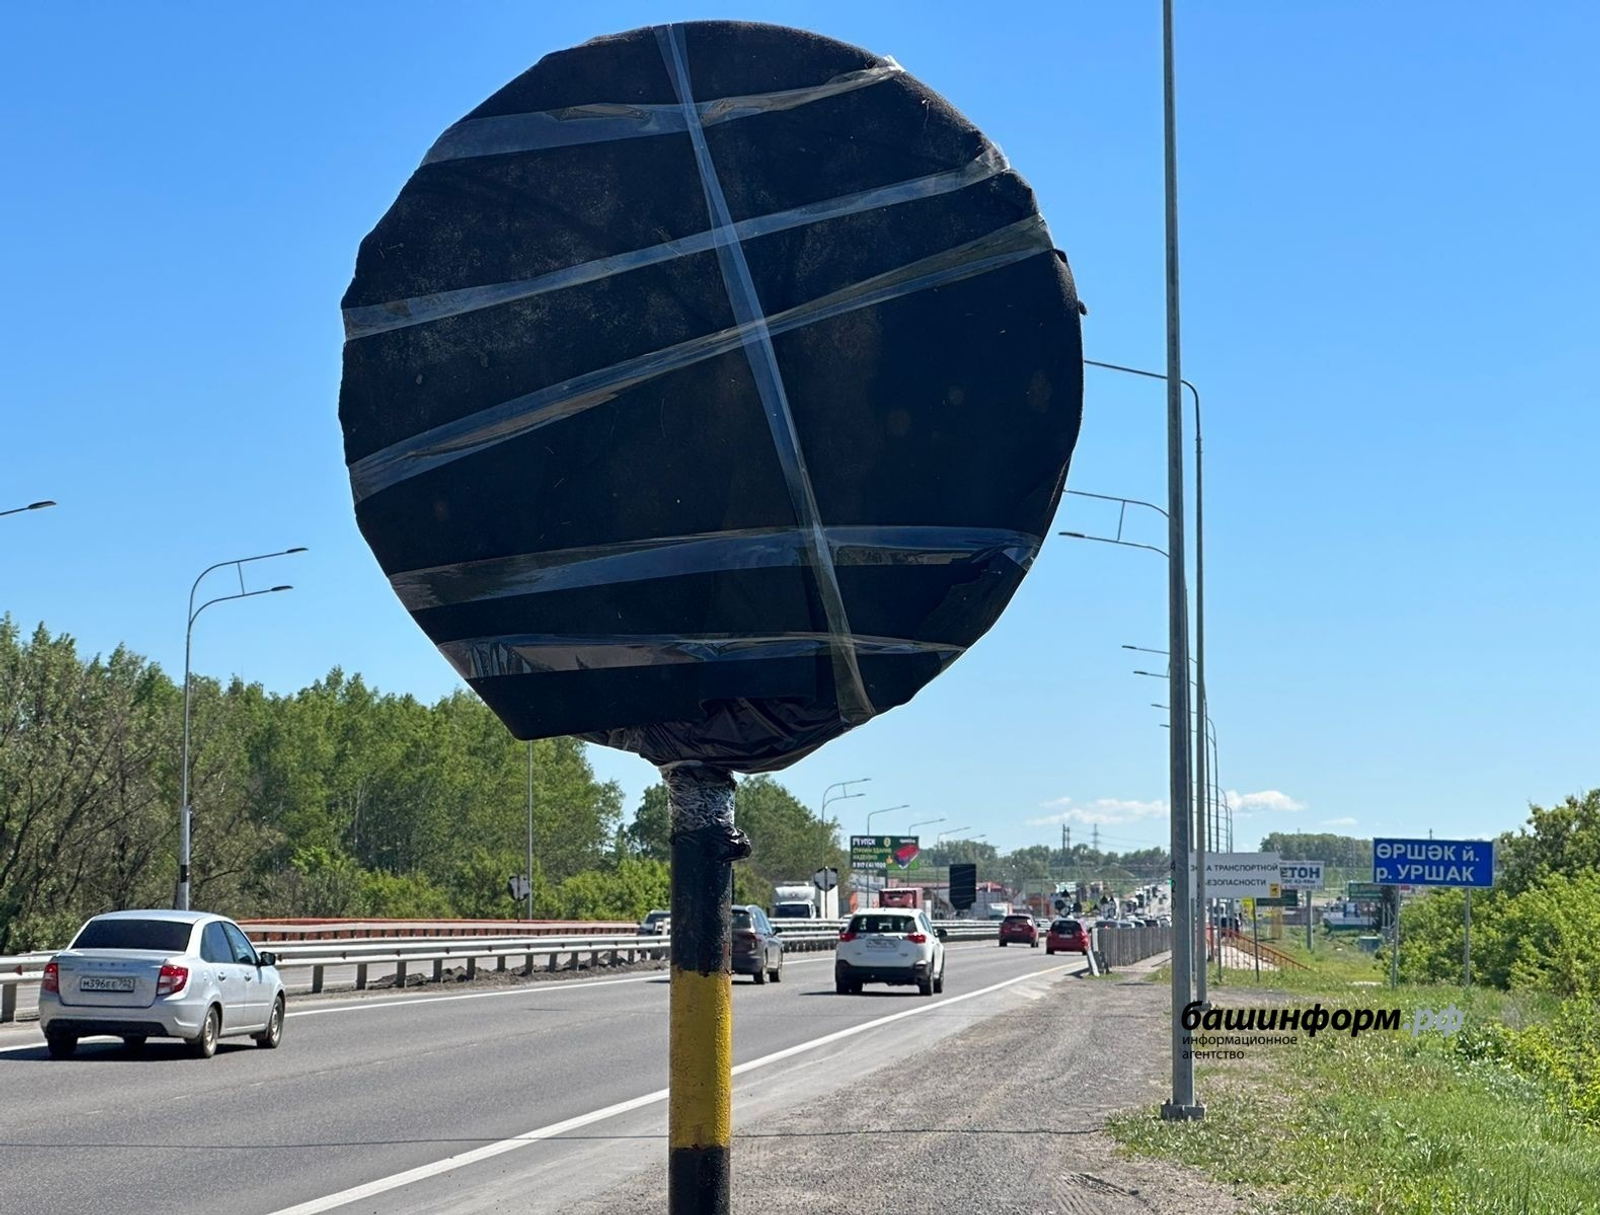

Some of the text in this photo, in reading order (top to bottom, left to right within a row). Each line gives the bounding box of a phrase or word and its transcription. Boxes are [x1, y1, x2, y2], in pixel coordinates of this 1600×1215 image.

[1376, 843, 1480, 862] ӨРШӘК й.
[1214, 864, 1278, 872] ТРАНСПОРТНОЙ
[1376, 864, 1475, 882] р. УРШАК
